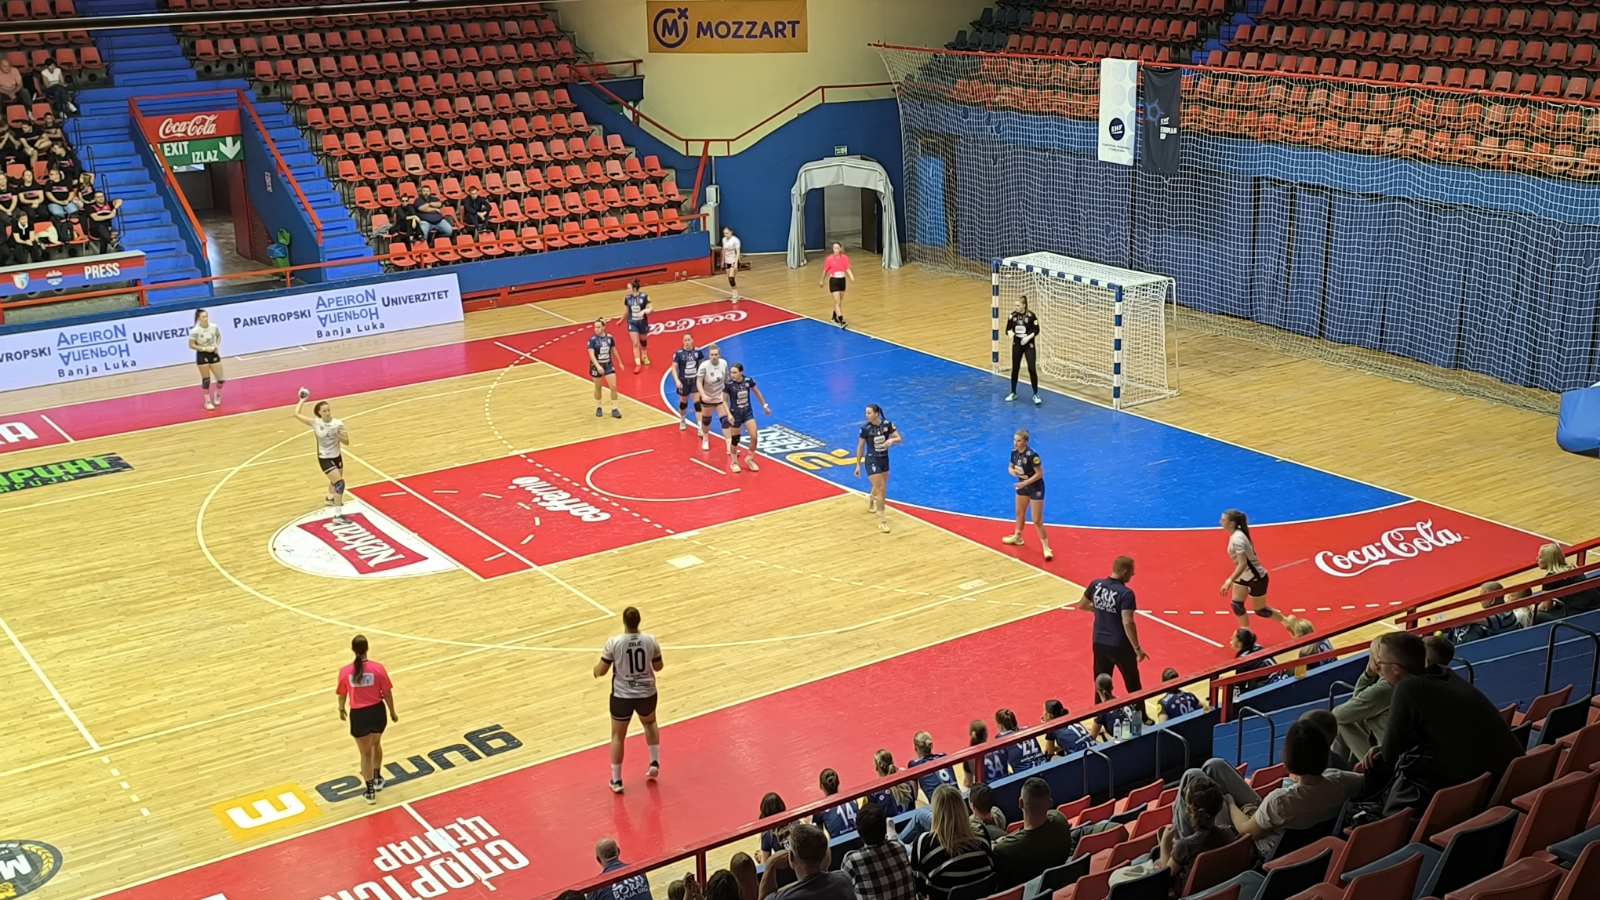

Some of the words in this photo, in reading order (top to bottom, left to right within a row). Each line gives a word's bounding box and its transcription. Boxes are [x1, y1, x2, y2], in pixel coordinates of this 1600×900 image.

[696, 20, 801, 39] MOZZART
[158, 114, 219, 139] Coca-Cola
[163, 141, 190, 157] EXIT
[191, 149, 219, 164] IZLAZ
[84, 262, 121, 280] PRESS
[232, 309, 311, 329] PANEVROPSKI
[381, 289, 449, 308] UNIVERZITET
[316, 325, 351, 339] Banja
[356, 321, 386, 333] Luka
[58, 364, 99, 378] Banja
[104, 359, 138, 372] Luka
[322, 521, 407, 568] Nektar
[1314, 518, 1463, 578] Coca-Cola
[626, 647, 646, 674] 10
[983, 754, 1004, 779] 34
[836, 801, 857, 827] 14
